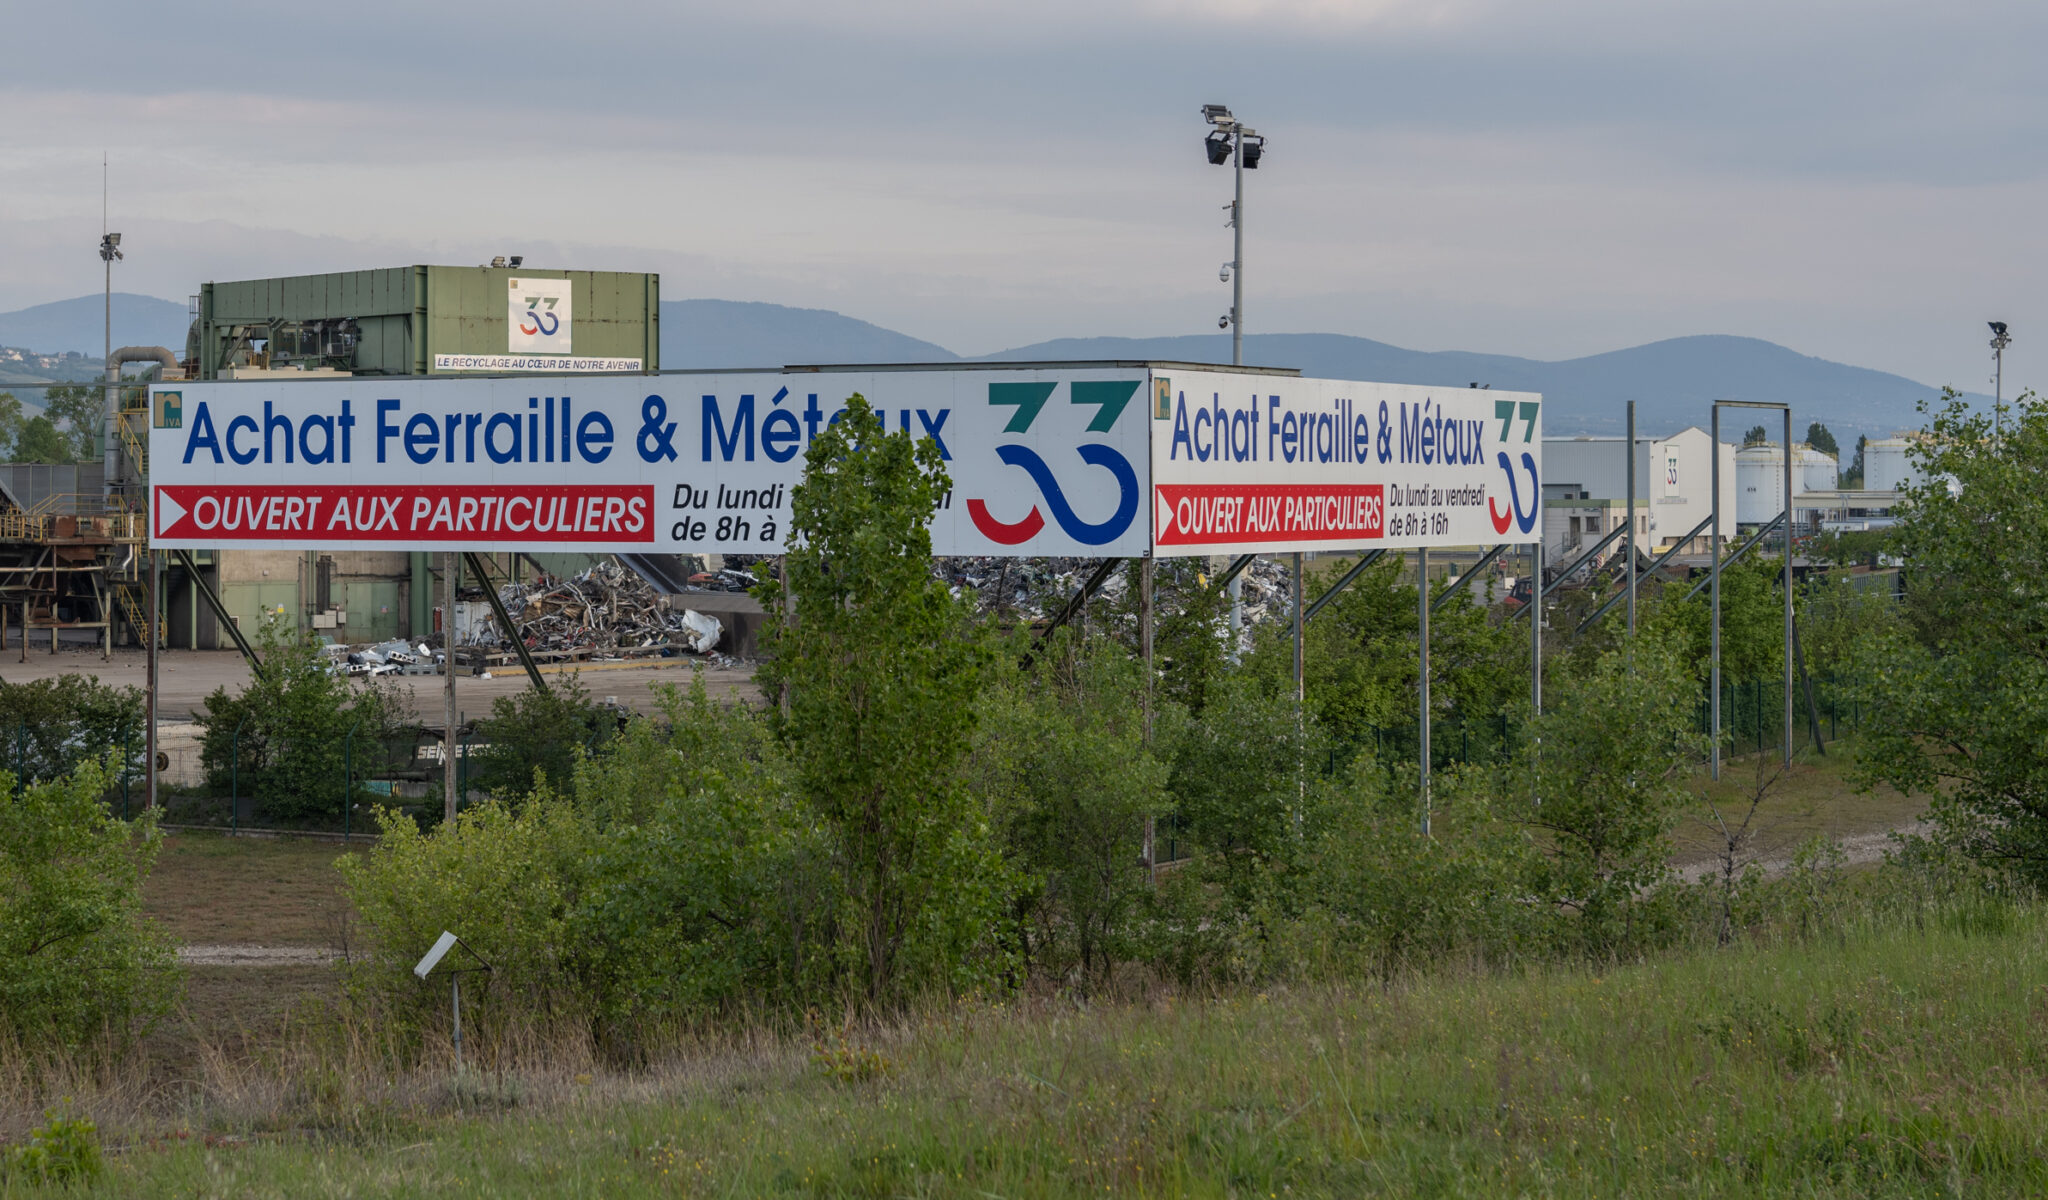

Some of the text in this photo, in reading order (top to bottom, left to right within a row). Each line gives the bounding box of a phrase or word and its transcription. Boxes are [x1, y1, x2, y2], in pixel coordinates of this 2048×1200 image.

[437, 357, 450, 367] LE
[452, 357, 510, 368] RECYCLAGE
[511, 359, 526, 368] AU
[558, 360, 571, 369] DE
[573, 360, 605, 370] NOTRE
[606, 361, 640, 370] AVENIR
[183, 386, 953, 465] Achat Ferraille & Métx
[1170, 390, 1485, 466] Achat Ferraille & Métaux
[672, 483, 709, 509] Du
[716, 483, 784, 510] lundi
[1390, 483, 1485, 507] Du lundi au vendredi
[193, 495, 647, 533] OUVERT AUX PARTICULIERS
[671, 515, 707, 542] de
[715, 515, 750, 542] 8h
[759, 514, 777, 542] à
[1177, 495, 1381, 535] OUVERT AUX PARTICULIERS
[1390, 512, 1449, 536] de 8h à 16h
